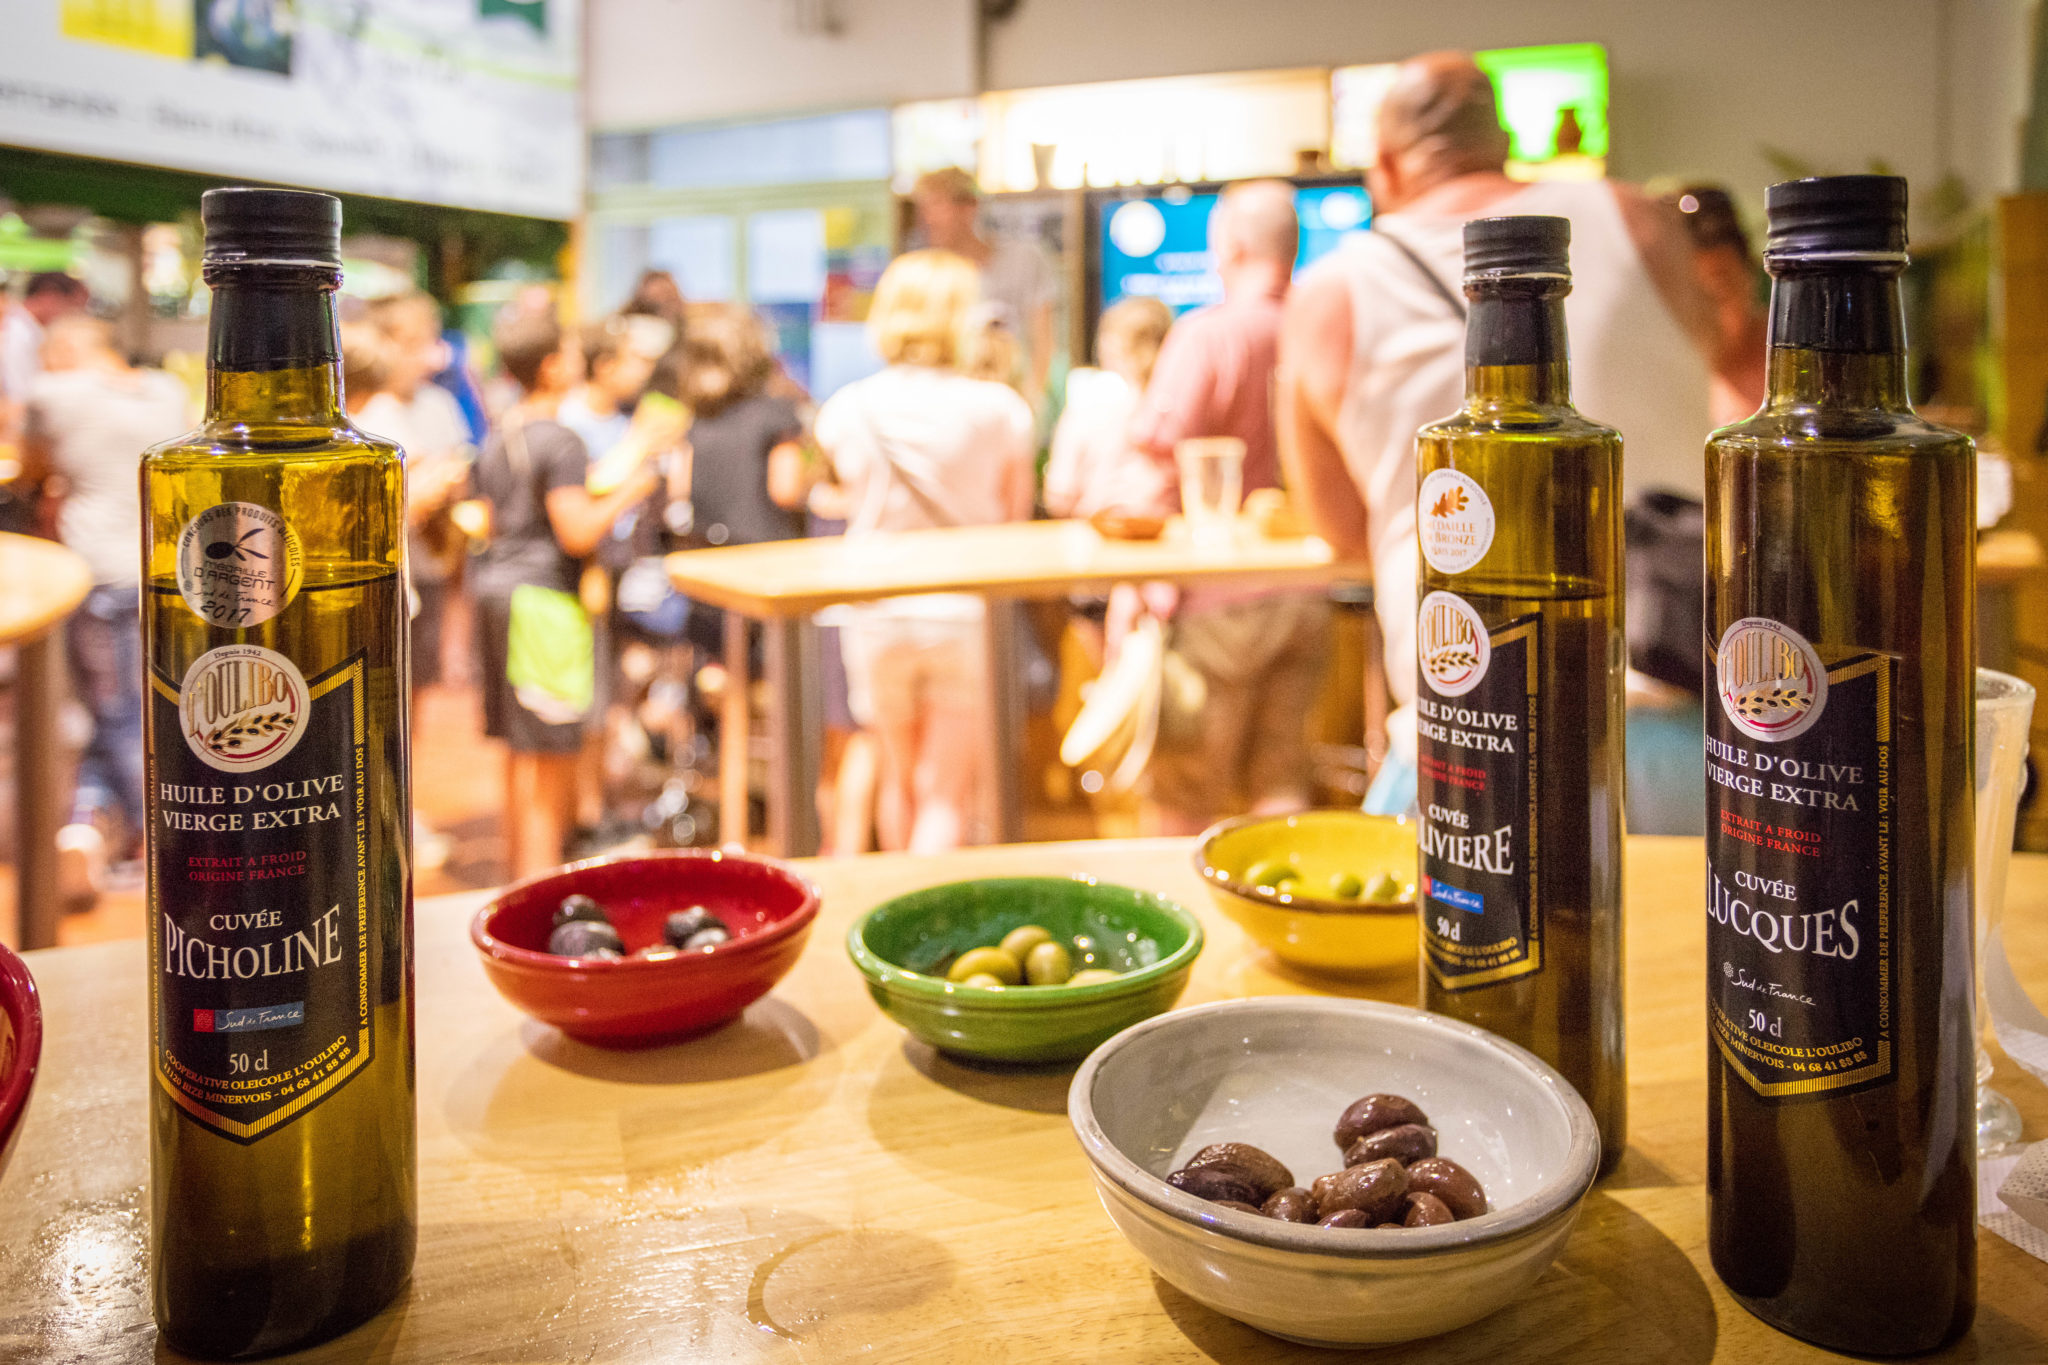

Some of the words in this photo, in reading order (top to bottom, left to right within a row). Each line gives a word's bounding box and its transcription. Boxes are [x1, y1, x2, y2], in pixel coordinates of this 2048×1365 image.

[182, 512, 214, 548] CONCOURS
[235, 506, 280, 529] PRODUITS
[1434, 531, 1478, 547] BRONZE
[200, 600, 252, 624] 2017
[242, 648, 262, 657] 1942
[1440, 705, 1519, 731] D'OLIVE
[1450, 728, 1515, 754] EXTRA
[355, 747, 364, 769] DOS
[1705, 735, 1749, 767] HUILE
[1755, 752, 1865, 784] D'OLIVE
[1878, 745, 1888, 768] DOS
[160, 782, 227, 805] HUILE
[233, 773, 345, 805] D'OLIVE
[356, 771, 365, 786] AU
[1706, 760, 1764, 797] VIERGE
[1770, 782, 1860, 811] EXTRA
[1878, 770, 1889, 786] AU
[356, 787, 365, 813] VOIR
[1878, 787, 1889, 814] VOIR
[162, 809, 245, 832] VIERGE
[252, 802, 342, 830] EXTRA
[356, 818, 366, 832] LE
[1428, 803, 1470, 830] CUVÉE
[1720, 808, 1762, 831] EXTRAIT
[1765, 824, 1774, 835] A
[1777, 826, 1822, 843] FROID
[1878, 821, 1889, 834] LE
[356, 834, 366, 868] AVANT
[1721, 823, 1763, 846] ORIGINE
[1766, 838, 1821, 857] FRANCE
[1878, 835, 1889, 872] AVANT
[187, 855, 244, 869] EXTRAIT
[247, 857, 257, 868] A
[261, 850, 307, 866] FROID
[188, 870, 245, 882] ORIGINE
[249, 864, 306, 881] FRANCE
[1734, 870, 1797, 901] CUVÉE
[356, 869, 367, 933] PREFERENCE
[1707, 855, 1860, 960] LUCQUES
[1878, 874, 1889, 940] PREFERENCE
[209, 908, 284, 931] CUVÉE
[1436, 915, 1450, 938] 50
[163, 903, 343, 981] PICHOLINE
[358, 933, 367, 949] DE
[1879, 941, 1889, 957] DE
[358, 950, 368, 1018] CONSOMMER
[1731, 969, 1757, 990] Sud
[1767, 982, 1817, 1006] France
[1879, 958, 1889, 1029] CONSOMMER
[217, 1010, 246, 1031] Sud
[257, 1009, 303, 1026] France
[1748, 1008, 1766, 1032] 50
[1769, 1017, 1782, 1038] cl
[1730, 1037, 1785, 1069] MINERVOIS
[1793, 1061, 1806, 1073] 04
[1808, 1061, 1823, 1072] 68
[1824, 1060, 1838, 1071] 41
[1839, 1053, 1854, 1068] 88
[1854, 1050, 1868, 1063] 88
[1749, 1036, 1804, 1058] OLEICOLE
[1805, 1036, 1863, 1058] L'OULIBO
[164, 1048, 230, 1090] COOPERATIVE
[230, 1069, 293, 1091] OLEICOLE
[295, 1034, 348, 1078] L'OULIBO
[204, 1090, 272, 1105] MINERVOIS
[280, 1084, 295, 1097] 04
[296, 1077, 311, 1090] 68
[311, 1069, 326, 1083] 41
[326, 1058, 340, 1072] 88
[338, 1046, 352, 1061] 88
[229, 1052, 251, 1076] 50
[254, 1049, 269, 1073] cl
